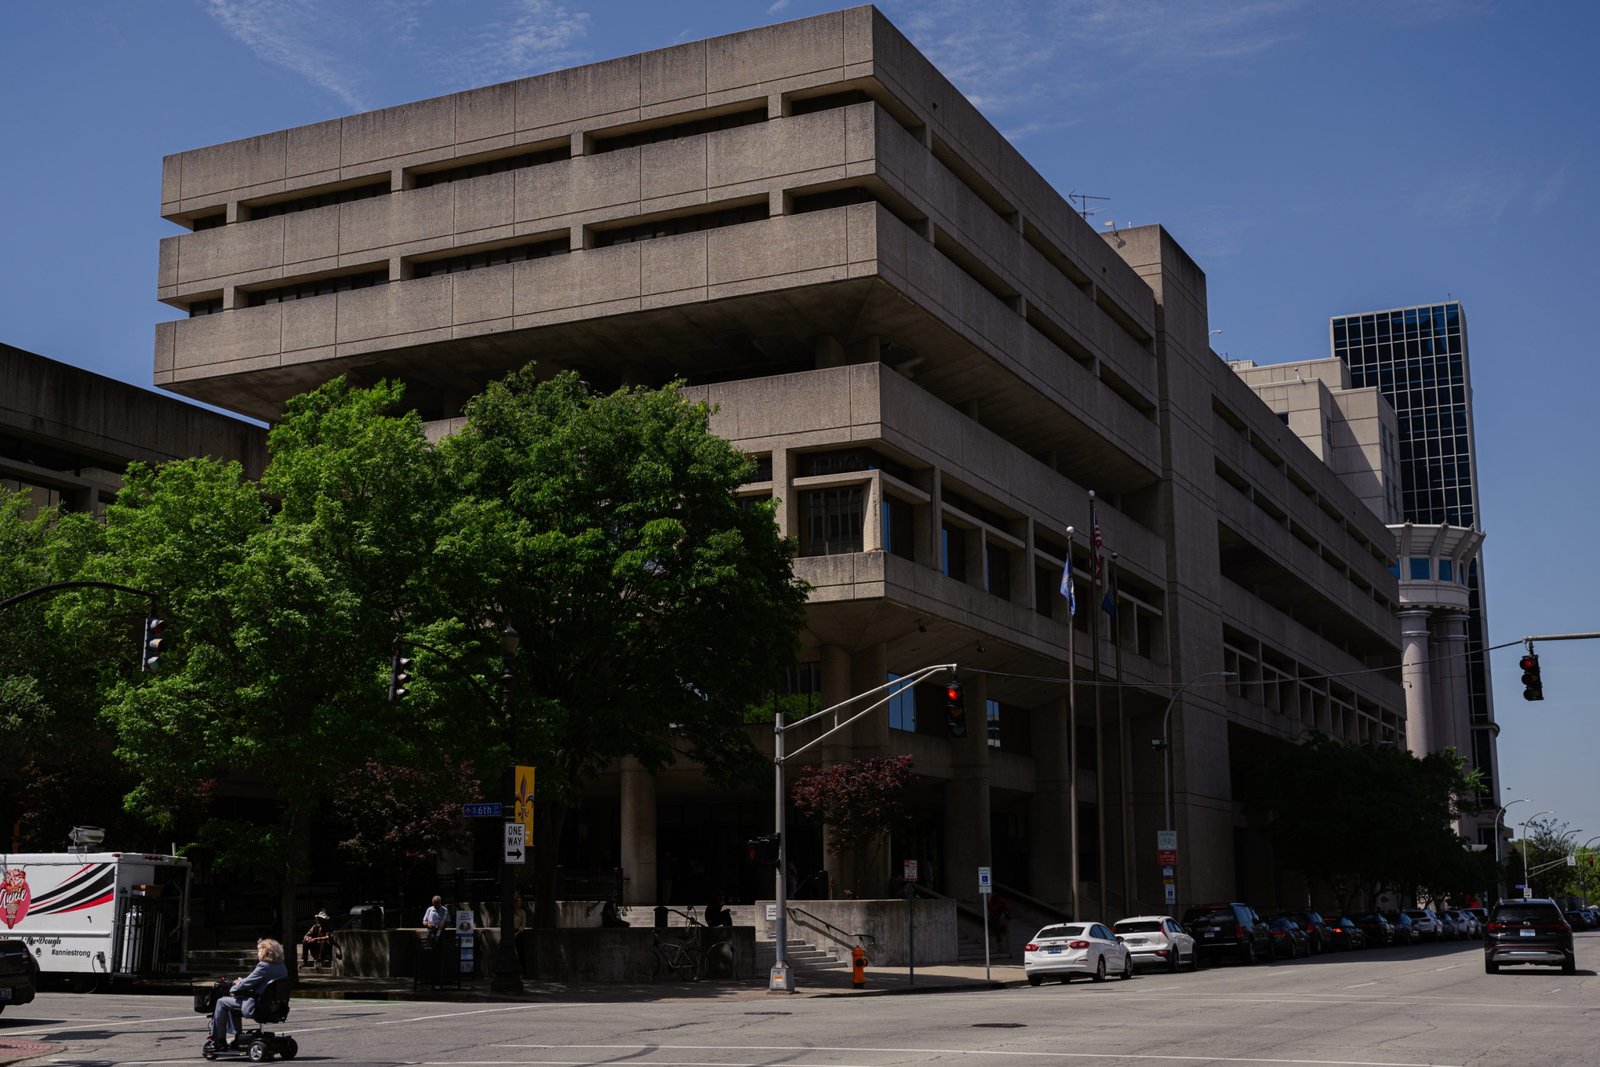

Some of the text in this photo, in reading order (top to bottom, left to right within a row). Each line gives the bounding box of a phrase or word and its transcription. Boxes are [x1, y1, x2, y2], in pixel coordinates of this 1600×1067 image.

[478, 805, 492, 815] 6th
[508, 826, 522, 836] ONE
[508, 837, 522, 846] WAY
[52, 949, 91, 958] #anniestrong
